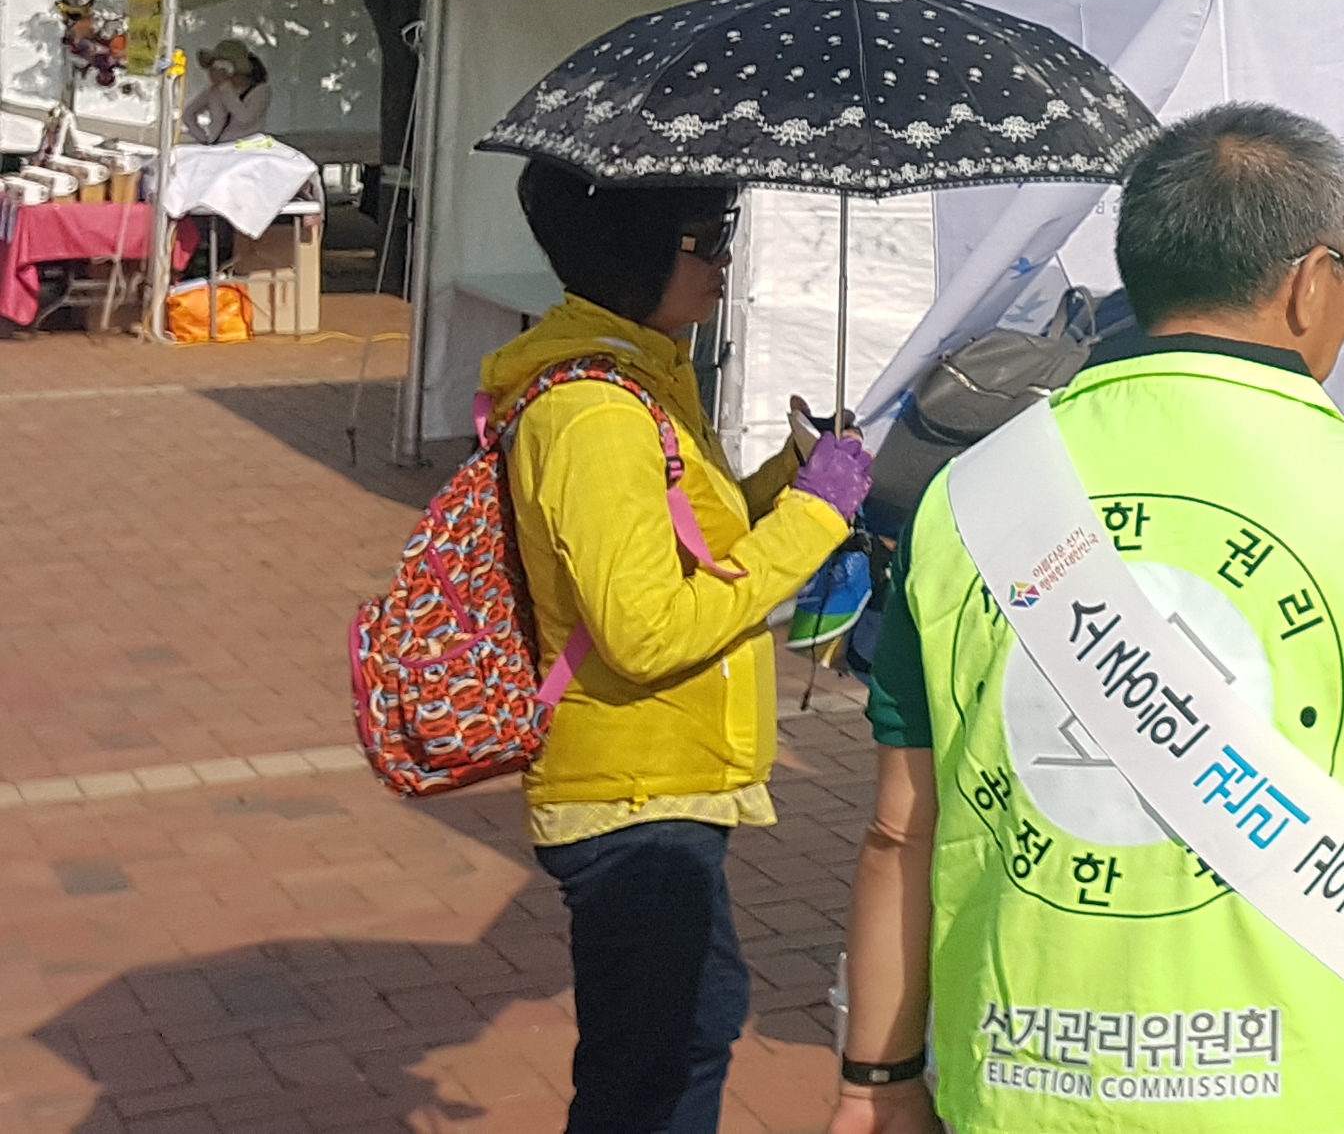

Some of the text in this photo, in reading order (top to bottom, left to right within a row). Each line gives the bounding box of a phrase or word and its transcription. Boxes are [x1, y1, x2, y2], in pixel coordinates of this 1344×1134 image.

[1216, 527, 1326, 641] 권리
[1068, 598, 1212, 759] 소중한
[1192, 743, 1312, 851] 권리
[973, 765, 1124, 908] 공정한
[981, 1002, 1280, 1069] 선거관리위원회
[987, 1061, 1280, 1100] ELECTION COMMISSION
